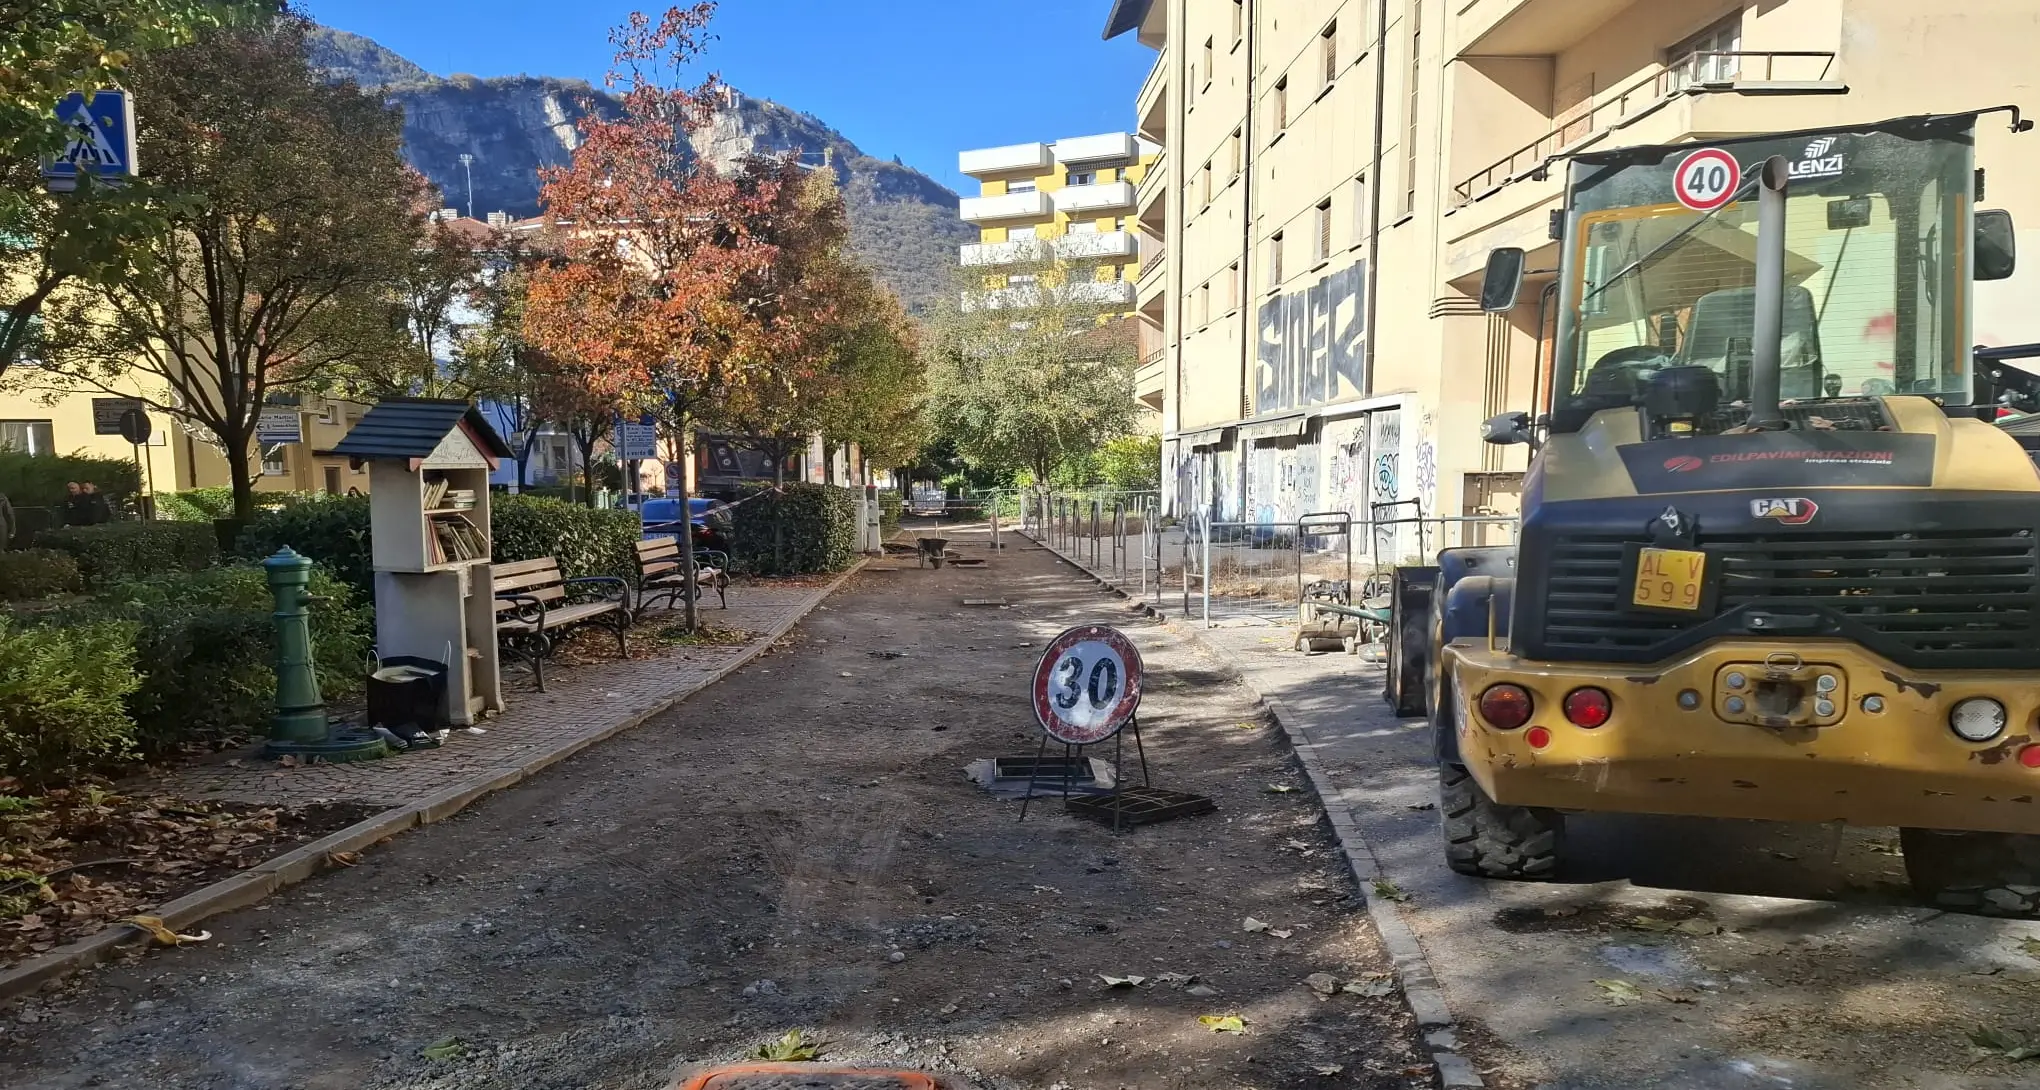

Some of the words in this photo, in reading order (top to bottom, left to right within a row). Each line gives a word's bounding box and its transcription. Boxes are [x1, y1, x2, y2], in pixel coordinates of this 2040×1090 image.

[1789, 155, 1843, 175] LENZI
[1688, 166, 1725, 193] 40
[1710, 450, 1894, 462] EDILPAVIMENTAZIONI
[1752, 499, 1800, 517] CAT
[1641, 554, 1668, 576] AL
[1689, 556, 1701, 579] V
[1056, 656, 1118, 710] 30
